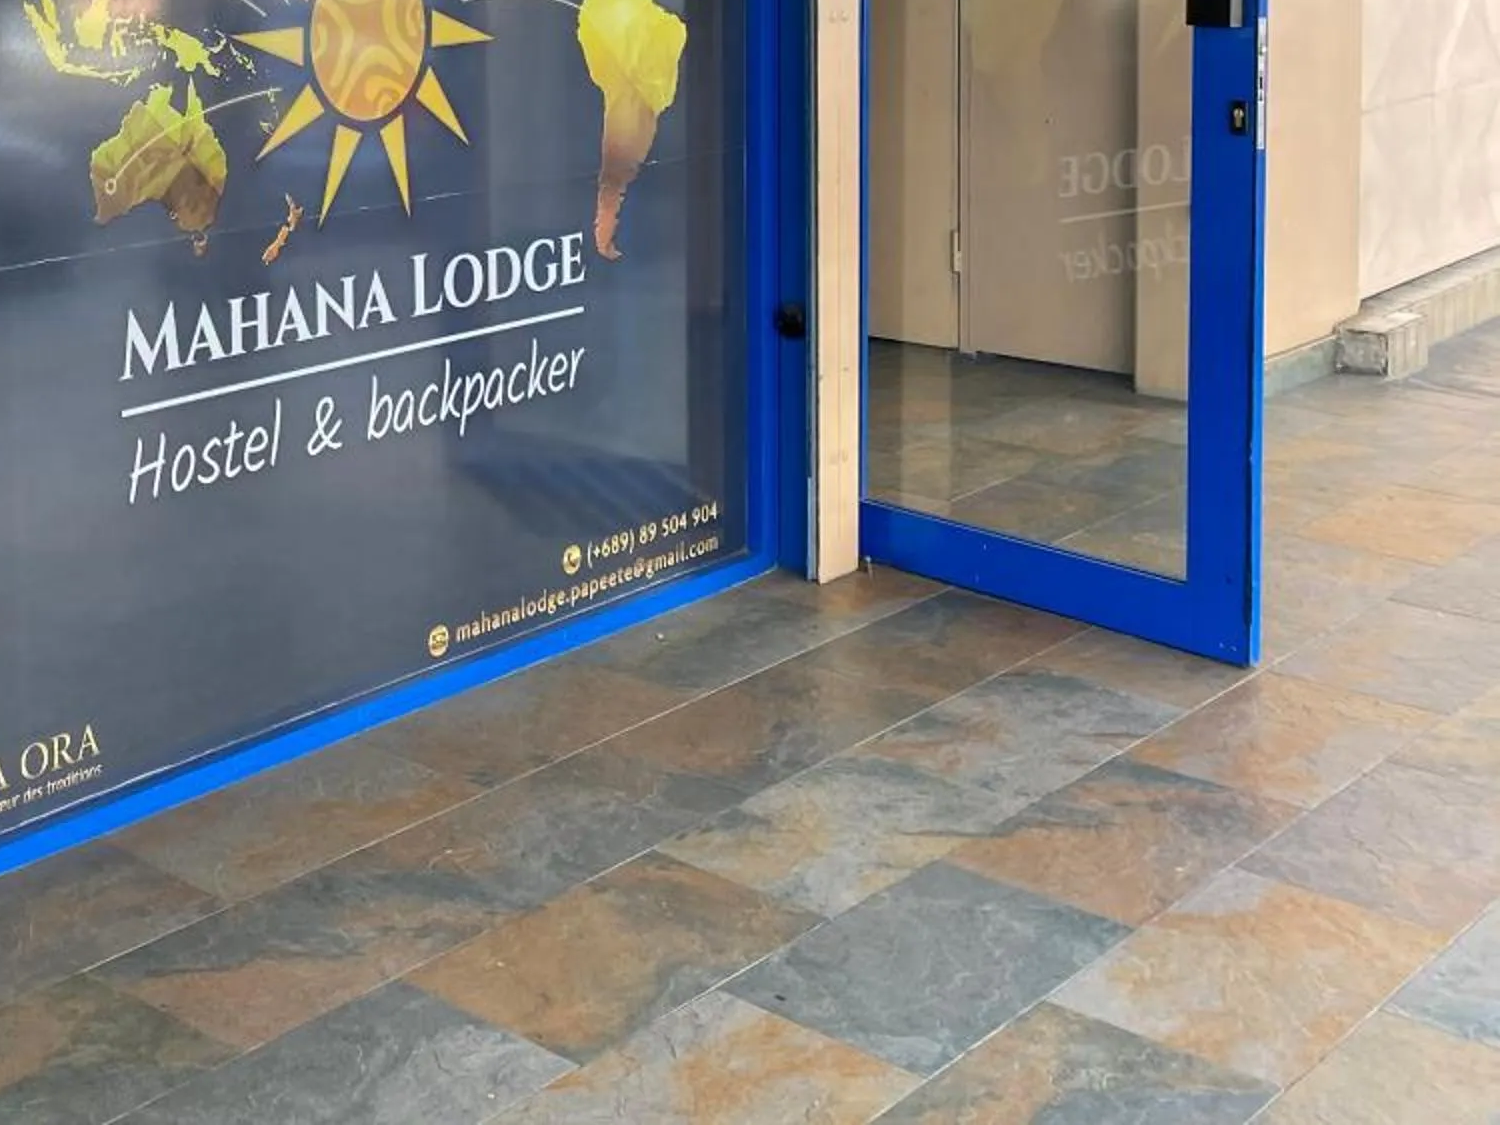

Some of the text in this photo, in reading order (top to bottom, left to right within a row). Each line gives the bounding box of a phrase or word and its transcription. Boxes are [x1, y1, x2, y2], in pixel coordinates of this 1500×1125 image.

[120, 231, 586, 381] MAHANA LODGE
[129, 339, 586, 503] Hostel & backpacker
[587, 500, 718, 568] (+689) 89 504 904
[455, 535, 719, 643] mahanalodge.papeete@gmail.com
[20, 723, 101, 780] ORA
[23, 784, 43, 805] des
[47, 763, 104, 795] traditions
